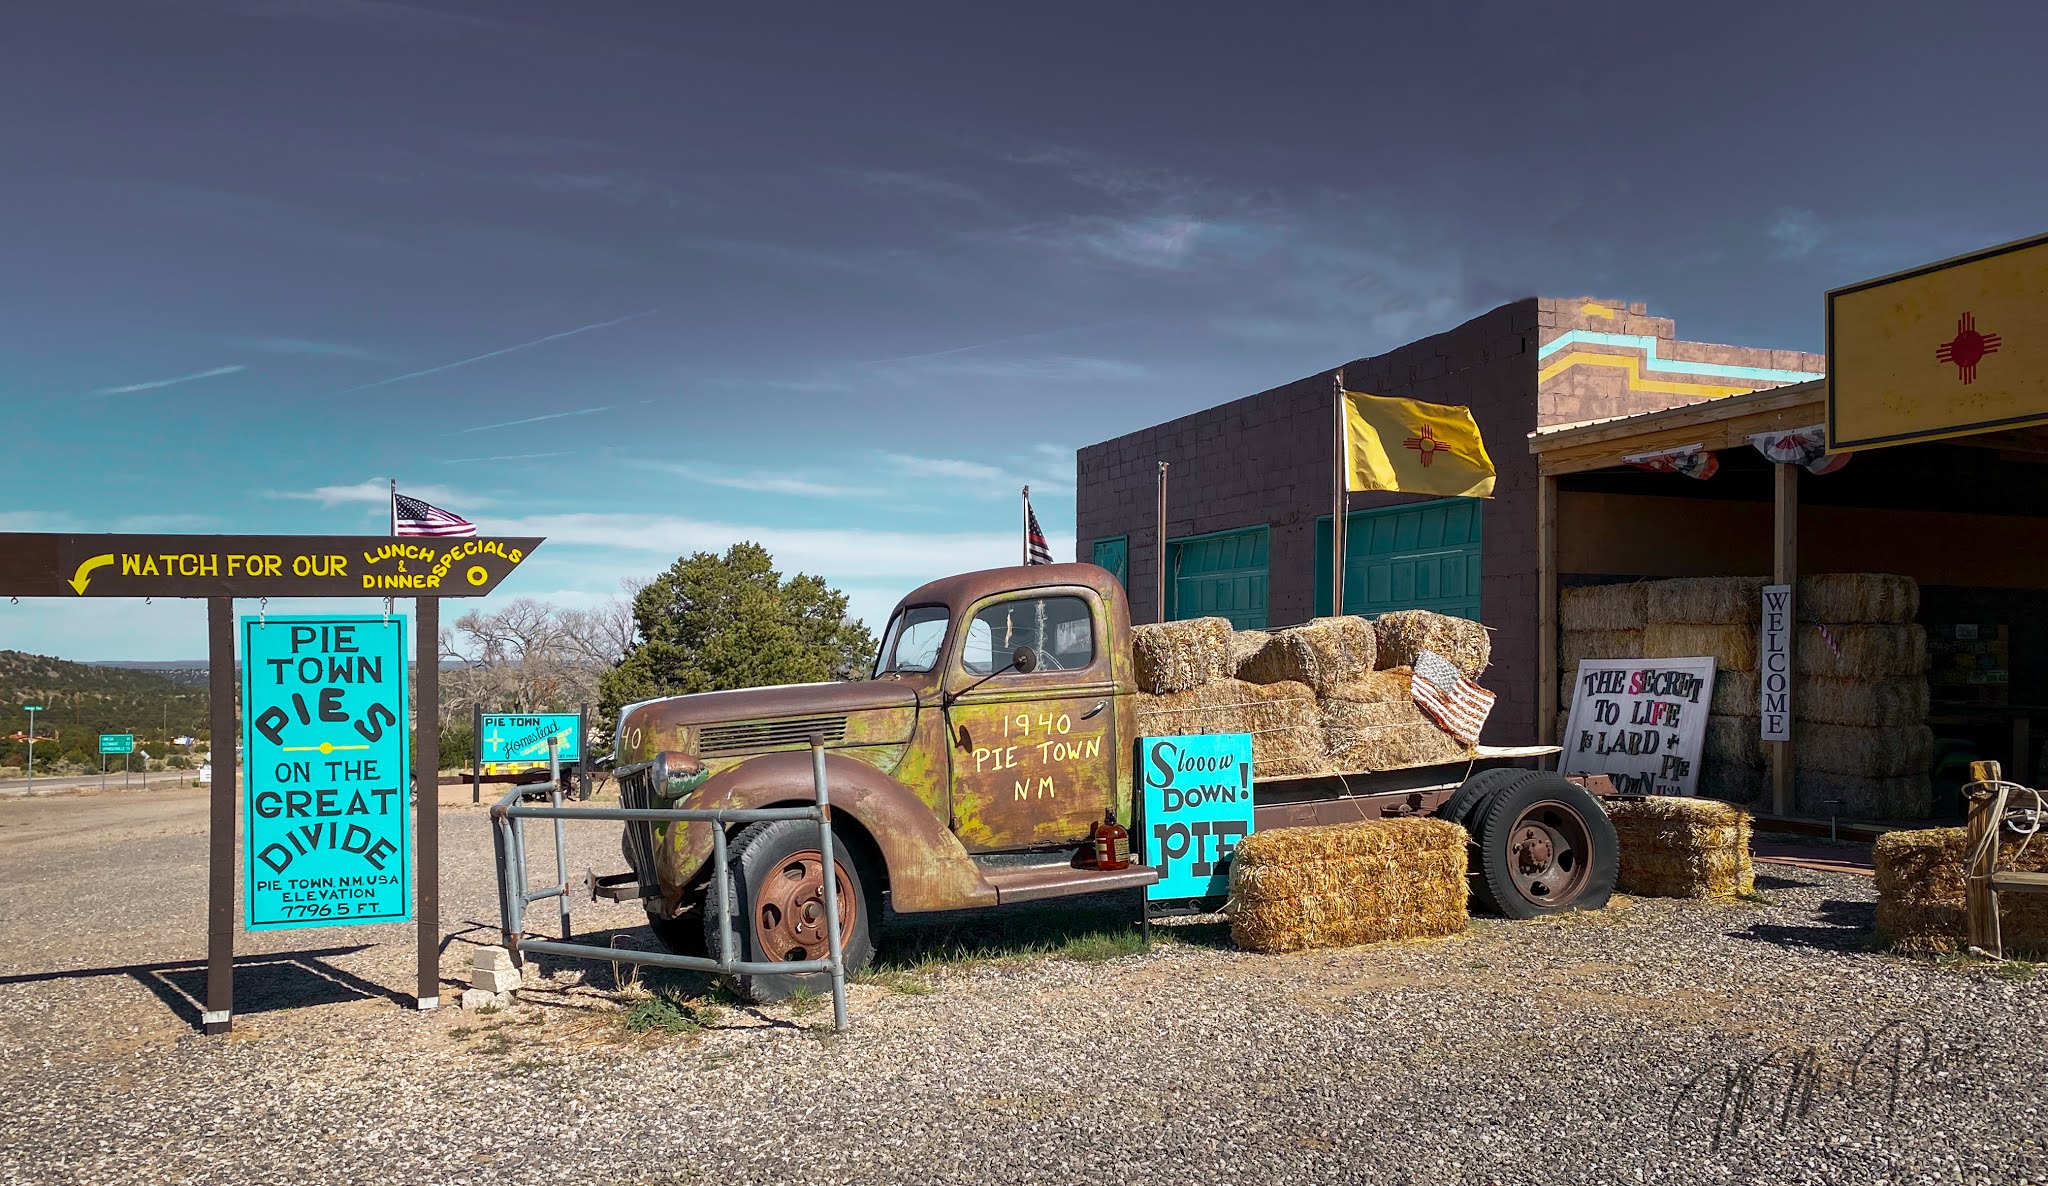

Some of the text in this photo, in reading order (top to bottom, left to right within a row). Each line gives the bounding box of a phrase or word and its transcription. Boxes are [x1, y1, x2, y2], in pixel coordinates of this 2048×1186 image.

[121, 553, 348, 577] WATCH FOR OUR
[362, 539, 523, 589] DINNER SPECIALS
[364, 543, 435, 564] LUNCH
[397, 560, 408, 573] &
[290, 625, 360, 654] PIE
[266, 656, 383, 684] TOWN
[1764, 592, 1789, 734] WELCOME
[1584, 669, 1704, 704] THE SECRET
[254, 687, 396, 746] PIES
[485, 718, 540, 727] PIE TOWN
[1004, 712, 1071, 738] 1940
[1594, 699, 1682, 729] TO LIFE
[502, 719, 560, 760] Homestead
[621, 725, 641, 751] 40
[1595, 729, 1660, 756] LARD
[972, 735, 1101, 773] PIE TOWN
[1146, 741, 1234, 789] Slooow
[1659, 754, 1691, 781] PIE
[274, 760, 381, 783] ON THE
[1162, 762, 1250, 813] DOWN!
[255, 787, 398, 819] GREAT
[257, 821, 398, 876] DIVIDE
[257, 880, 282, 891] PIE
[367, 875, 399, 885] USA
[282, 888, 375, 902] ELEVATION
[281, 902, 381, 918] 7796.5 FT.
